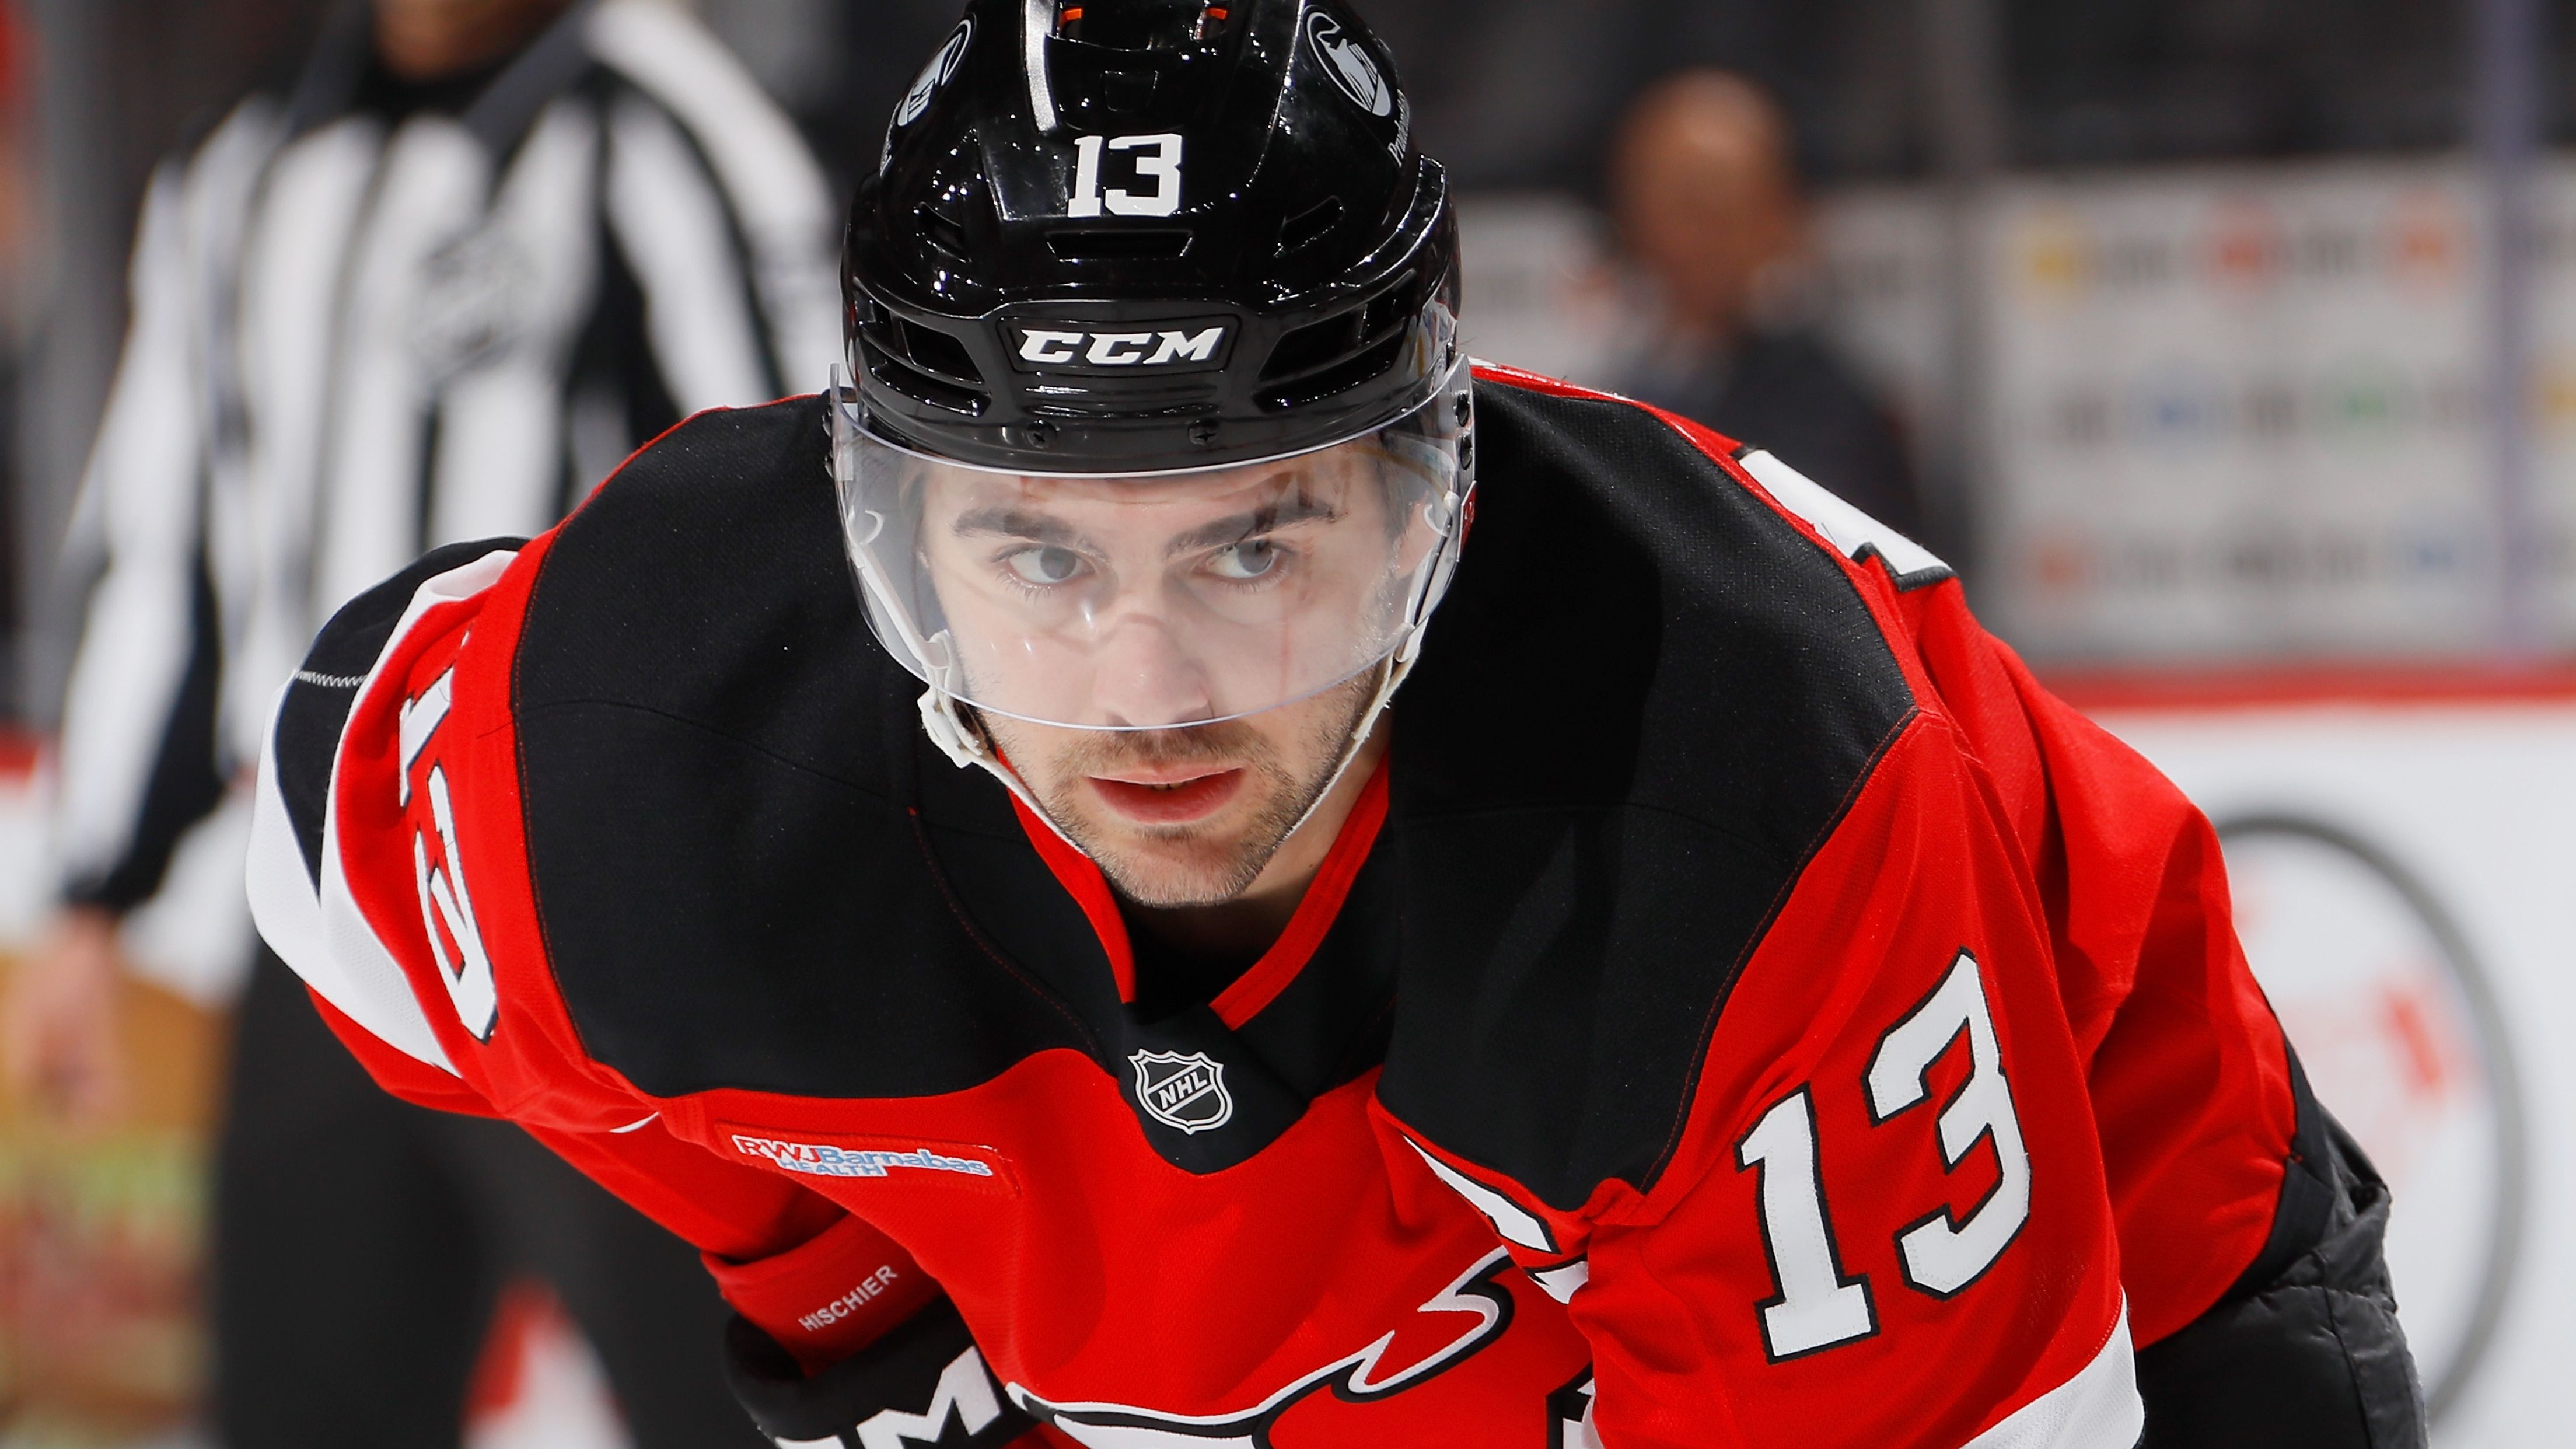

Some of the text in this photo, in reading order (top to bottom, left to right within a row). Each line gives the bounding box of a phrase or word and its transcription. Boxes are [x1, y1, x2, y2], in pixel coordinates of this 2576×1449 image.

[1068, 134, 1182, 217] 13
[1019, 327, 1224, 365] CCM
[1158, 1071, 1207, 1109] NHL
[776, 1157, 887, 1176] HEALTH
[1735, 947, 2032, 1363] 13
[798, 1265, 899, 1332] HISCHIER
